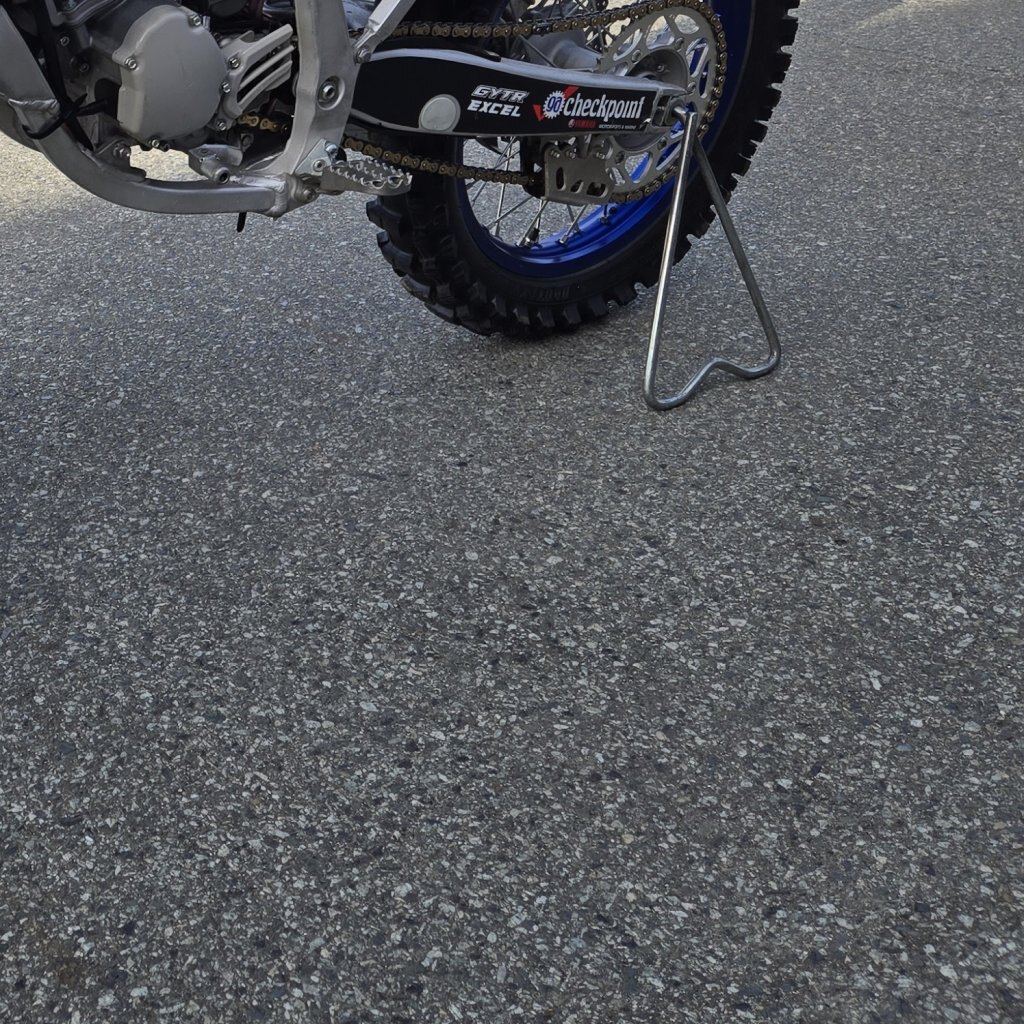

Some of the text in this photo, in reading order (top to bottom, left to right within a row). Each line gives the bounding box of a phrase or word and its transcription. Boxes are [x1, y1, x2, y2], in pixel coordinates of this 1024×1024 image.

[471, 84, 528, 104] GYTR
[467, 99, 522, 118] EXCEL
[563, 92, 646, 123] checkpoint
